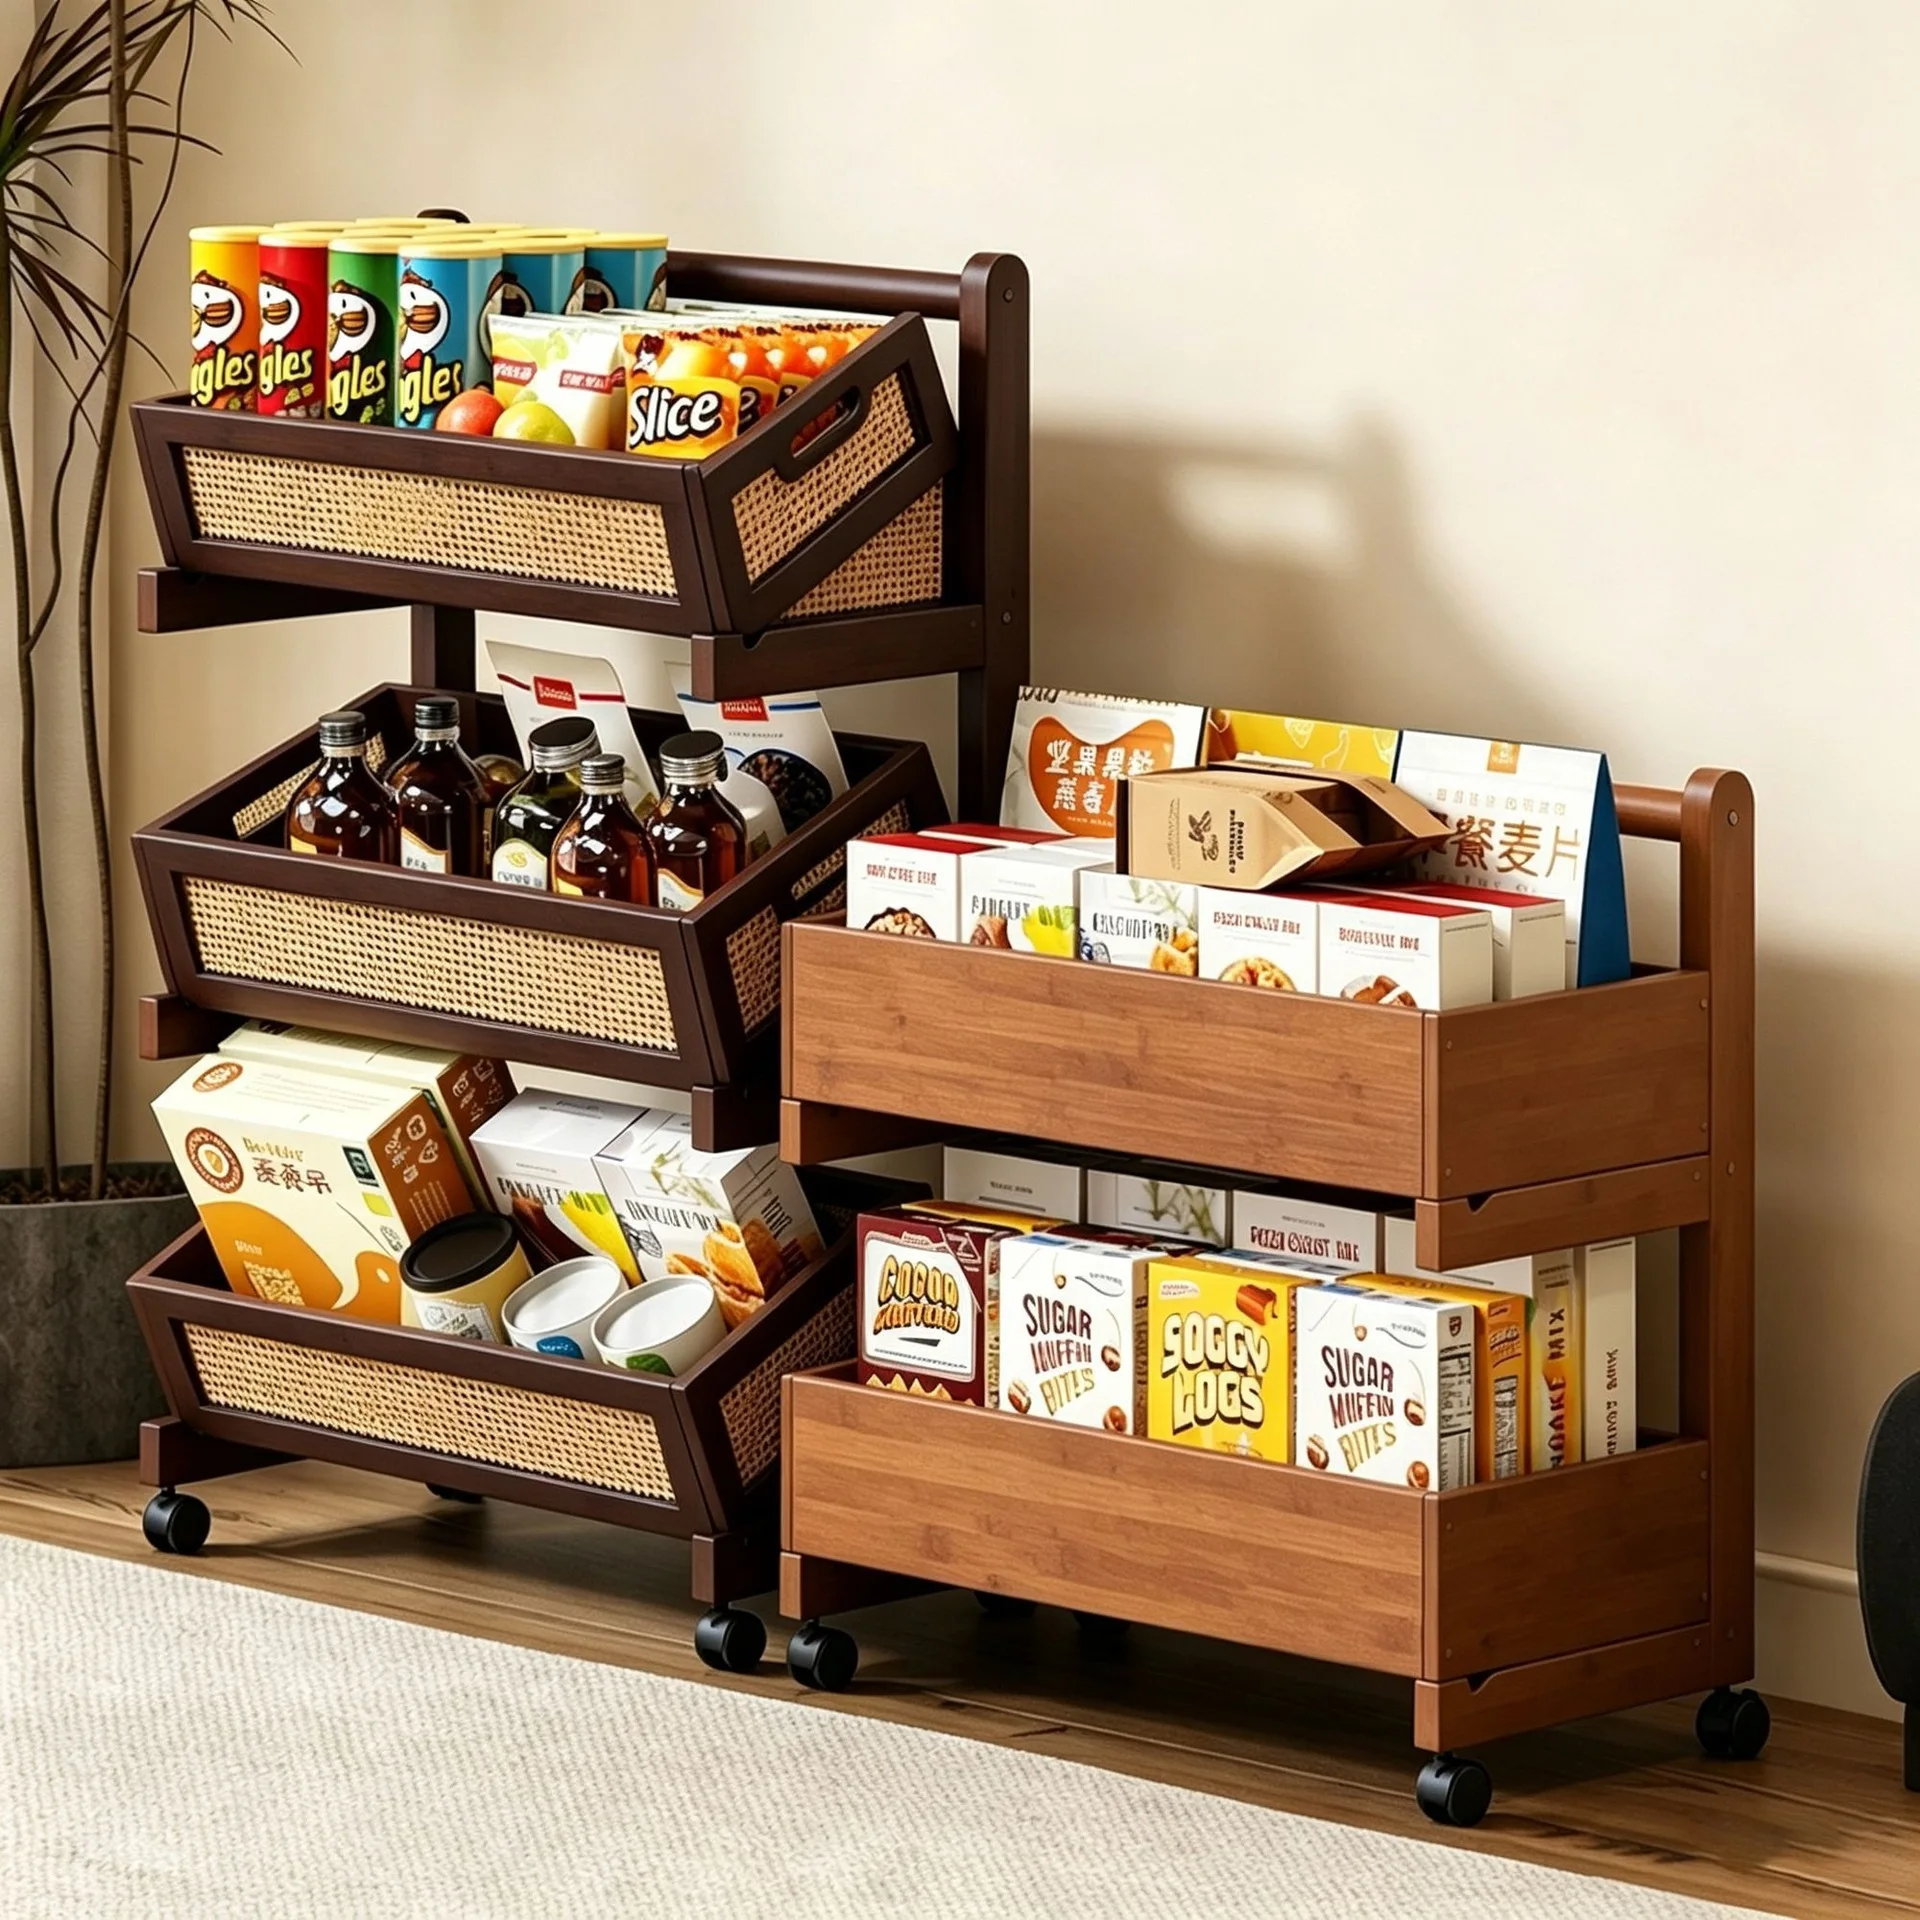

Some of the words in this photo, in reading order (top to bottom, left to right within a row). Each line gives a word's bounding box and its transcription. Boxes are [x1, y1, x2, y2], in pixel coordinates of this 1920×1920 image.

[629, 386, 721, 448] Slice
[1419, 810, 1581, 882] 餐麦片
[1022, 1293, 1093, 1340] SUGAR
[1161, 1311, 1270, 1379] SOGGY
[1547, 1307, 1566, 1361] MIX
[1321, 1345, 1394, 1393] SUGAR
[1172, 1369, 1265, 1436] LOGS
